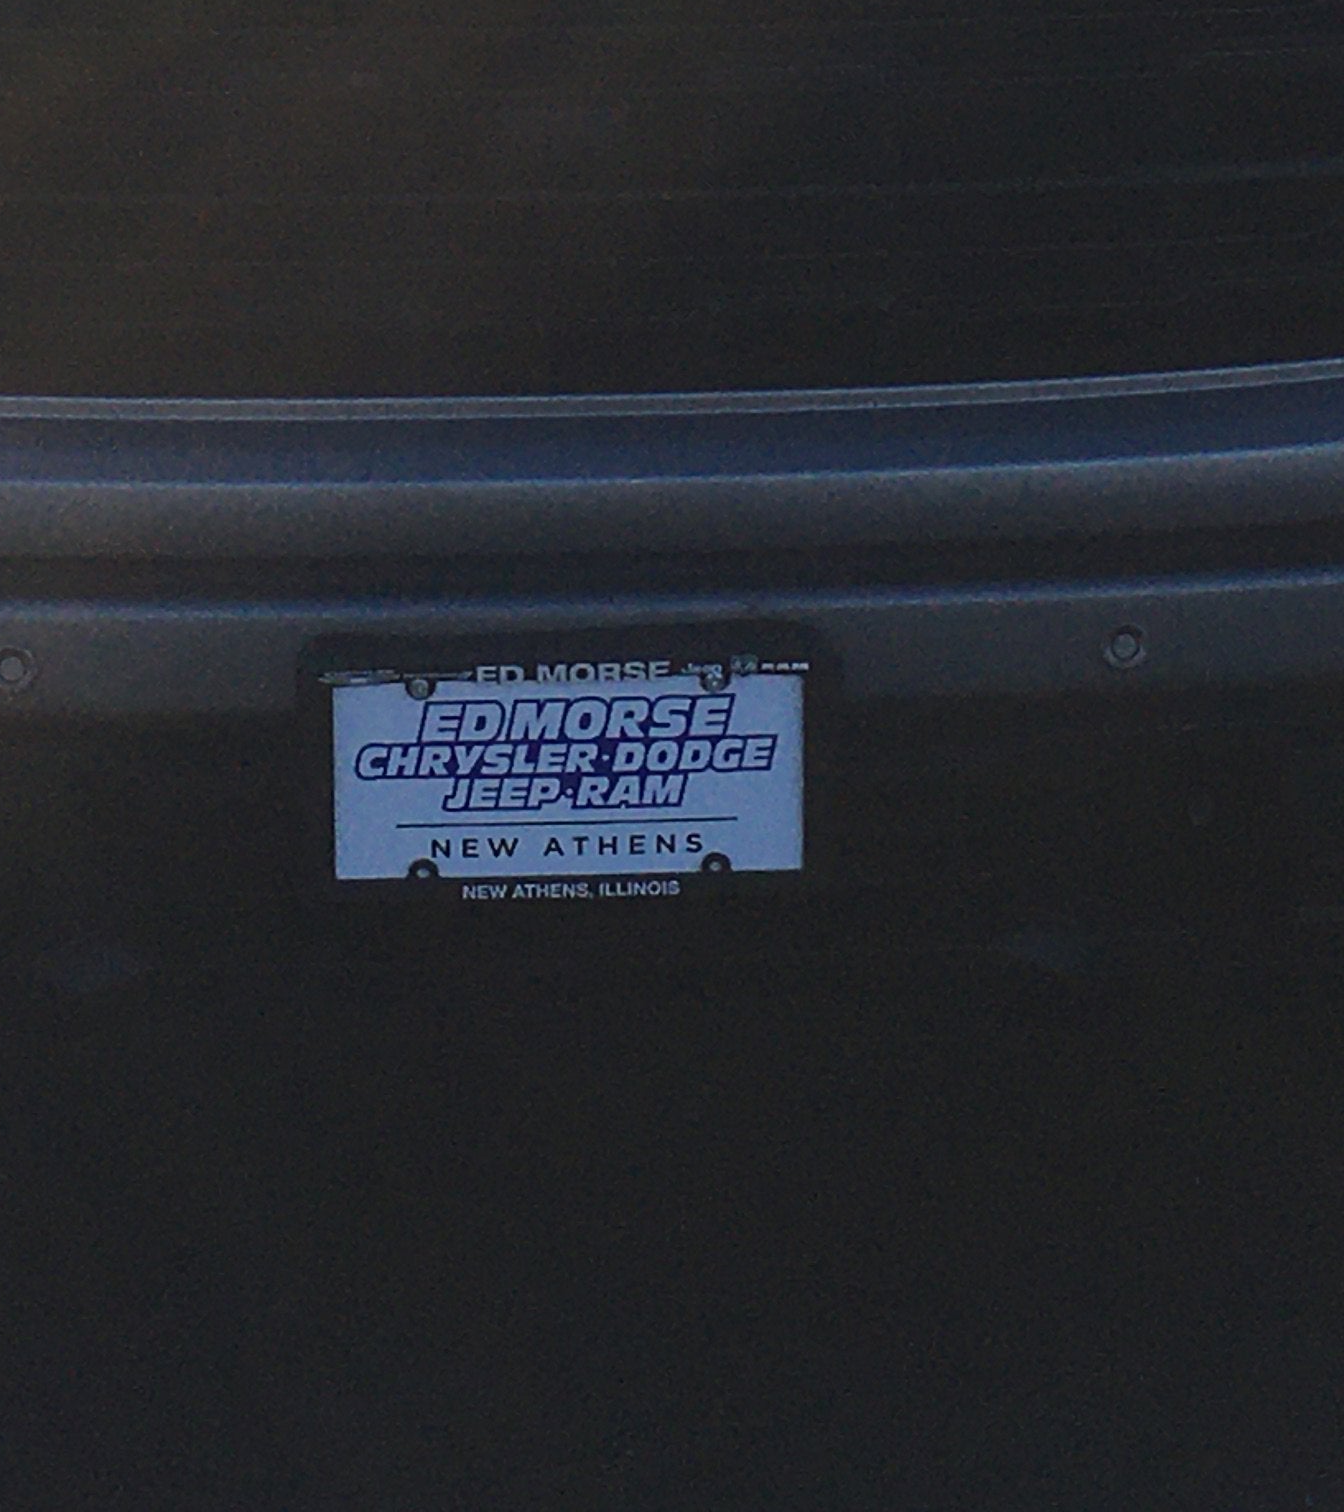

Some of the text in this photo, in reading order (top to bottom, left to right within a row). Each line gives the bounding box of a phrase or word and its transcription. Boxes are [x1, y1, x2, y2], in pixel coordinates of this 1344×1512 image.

[475, 665, 525, 685] ED
[536, 661, 671, 685] MORSE
[418, 693, 736, 742] ED MORSE
[430, 832, 704, 859] NEW ATHENS
[461, 879, 681, 900] NEW ATHENS, ILLINOIS
